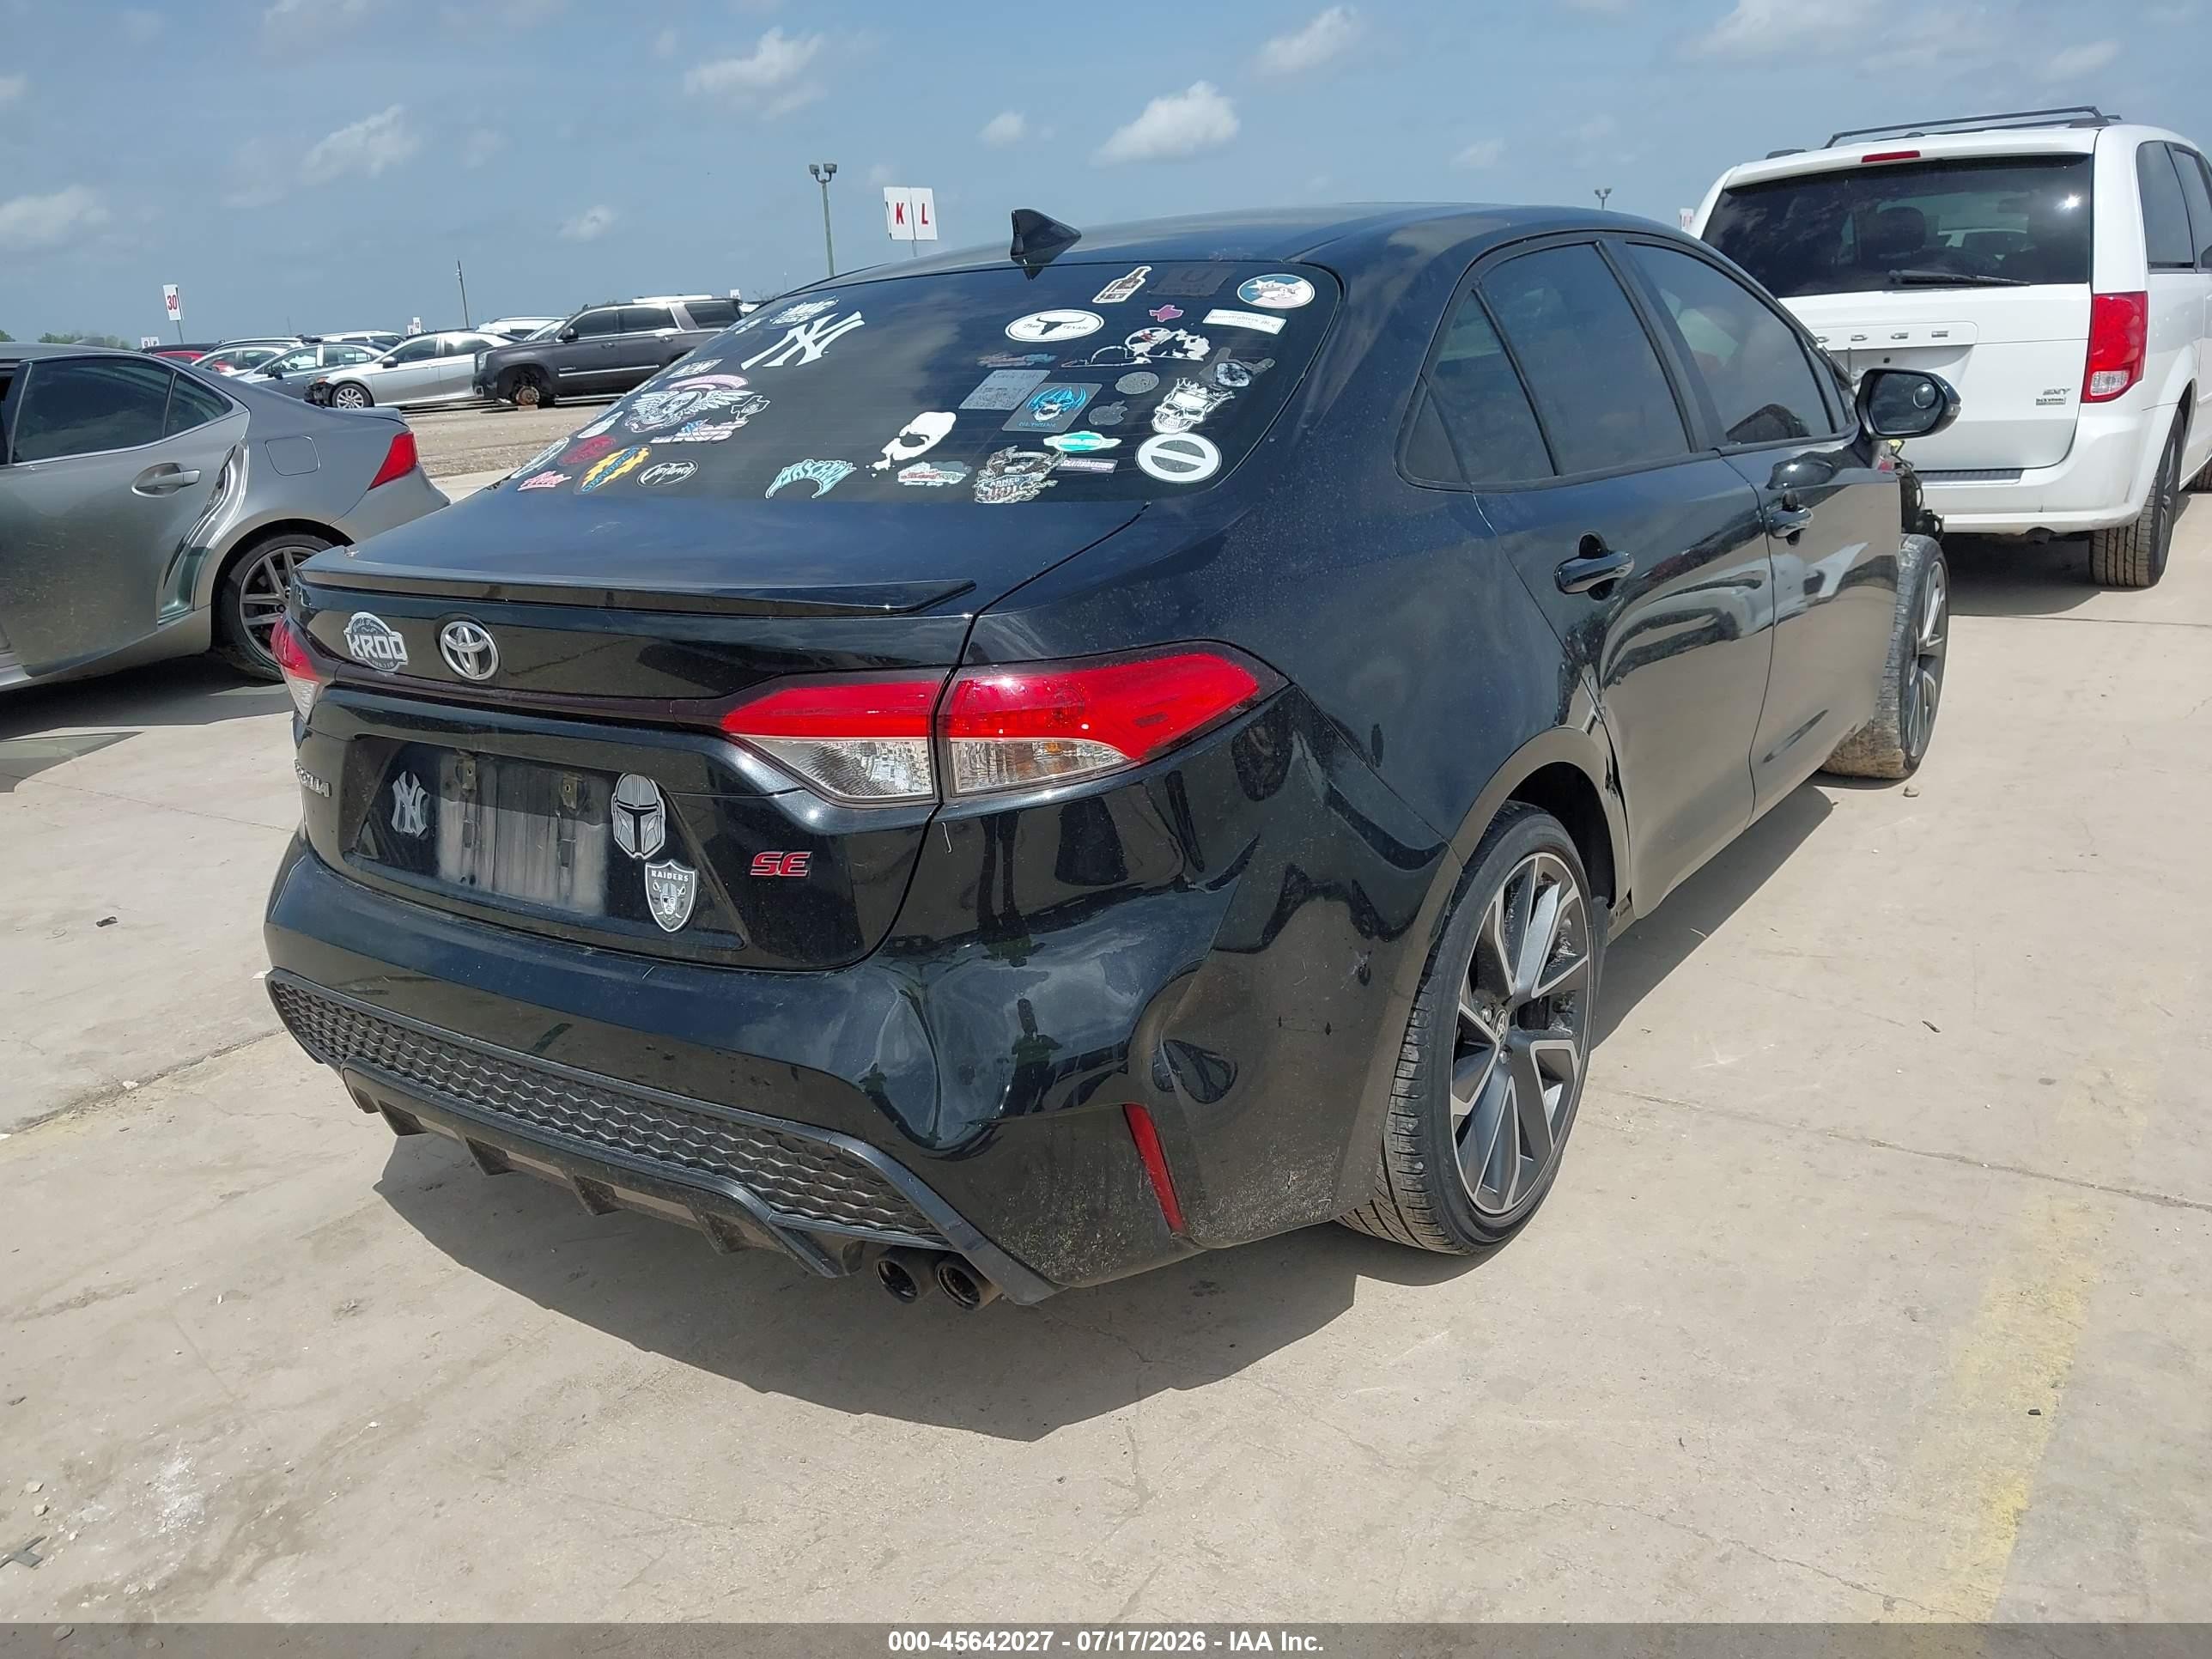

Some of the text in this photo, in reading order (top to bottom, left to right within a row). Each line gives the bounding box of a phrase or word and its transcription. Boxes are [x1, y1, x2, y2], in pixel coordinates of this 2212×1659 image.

[896, 202, 929, 225] K L
[167, 294, 178, 311] 30
[1816, 331, 1948, 343] ODGE
[750, 851, 812, 877] SE
[651, 869, 689, 882] RAIDERS
